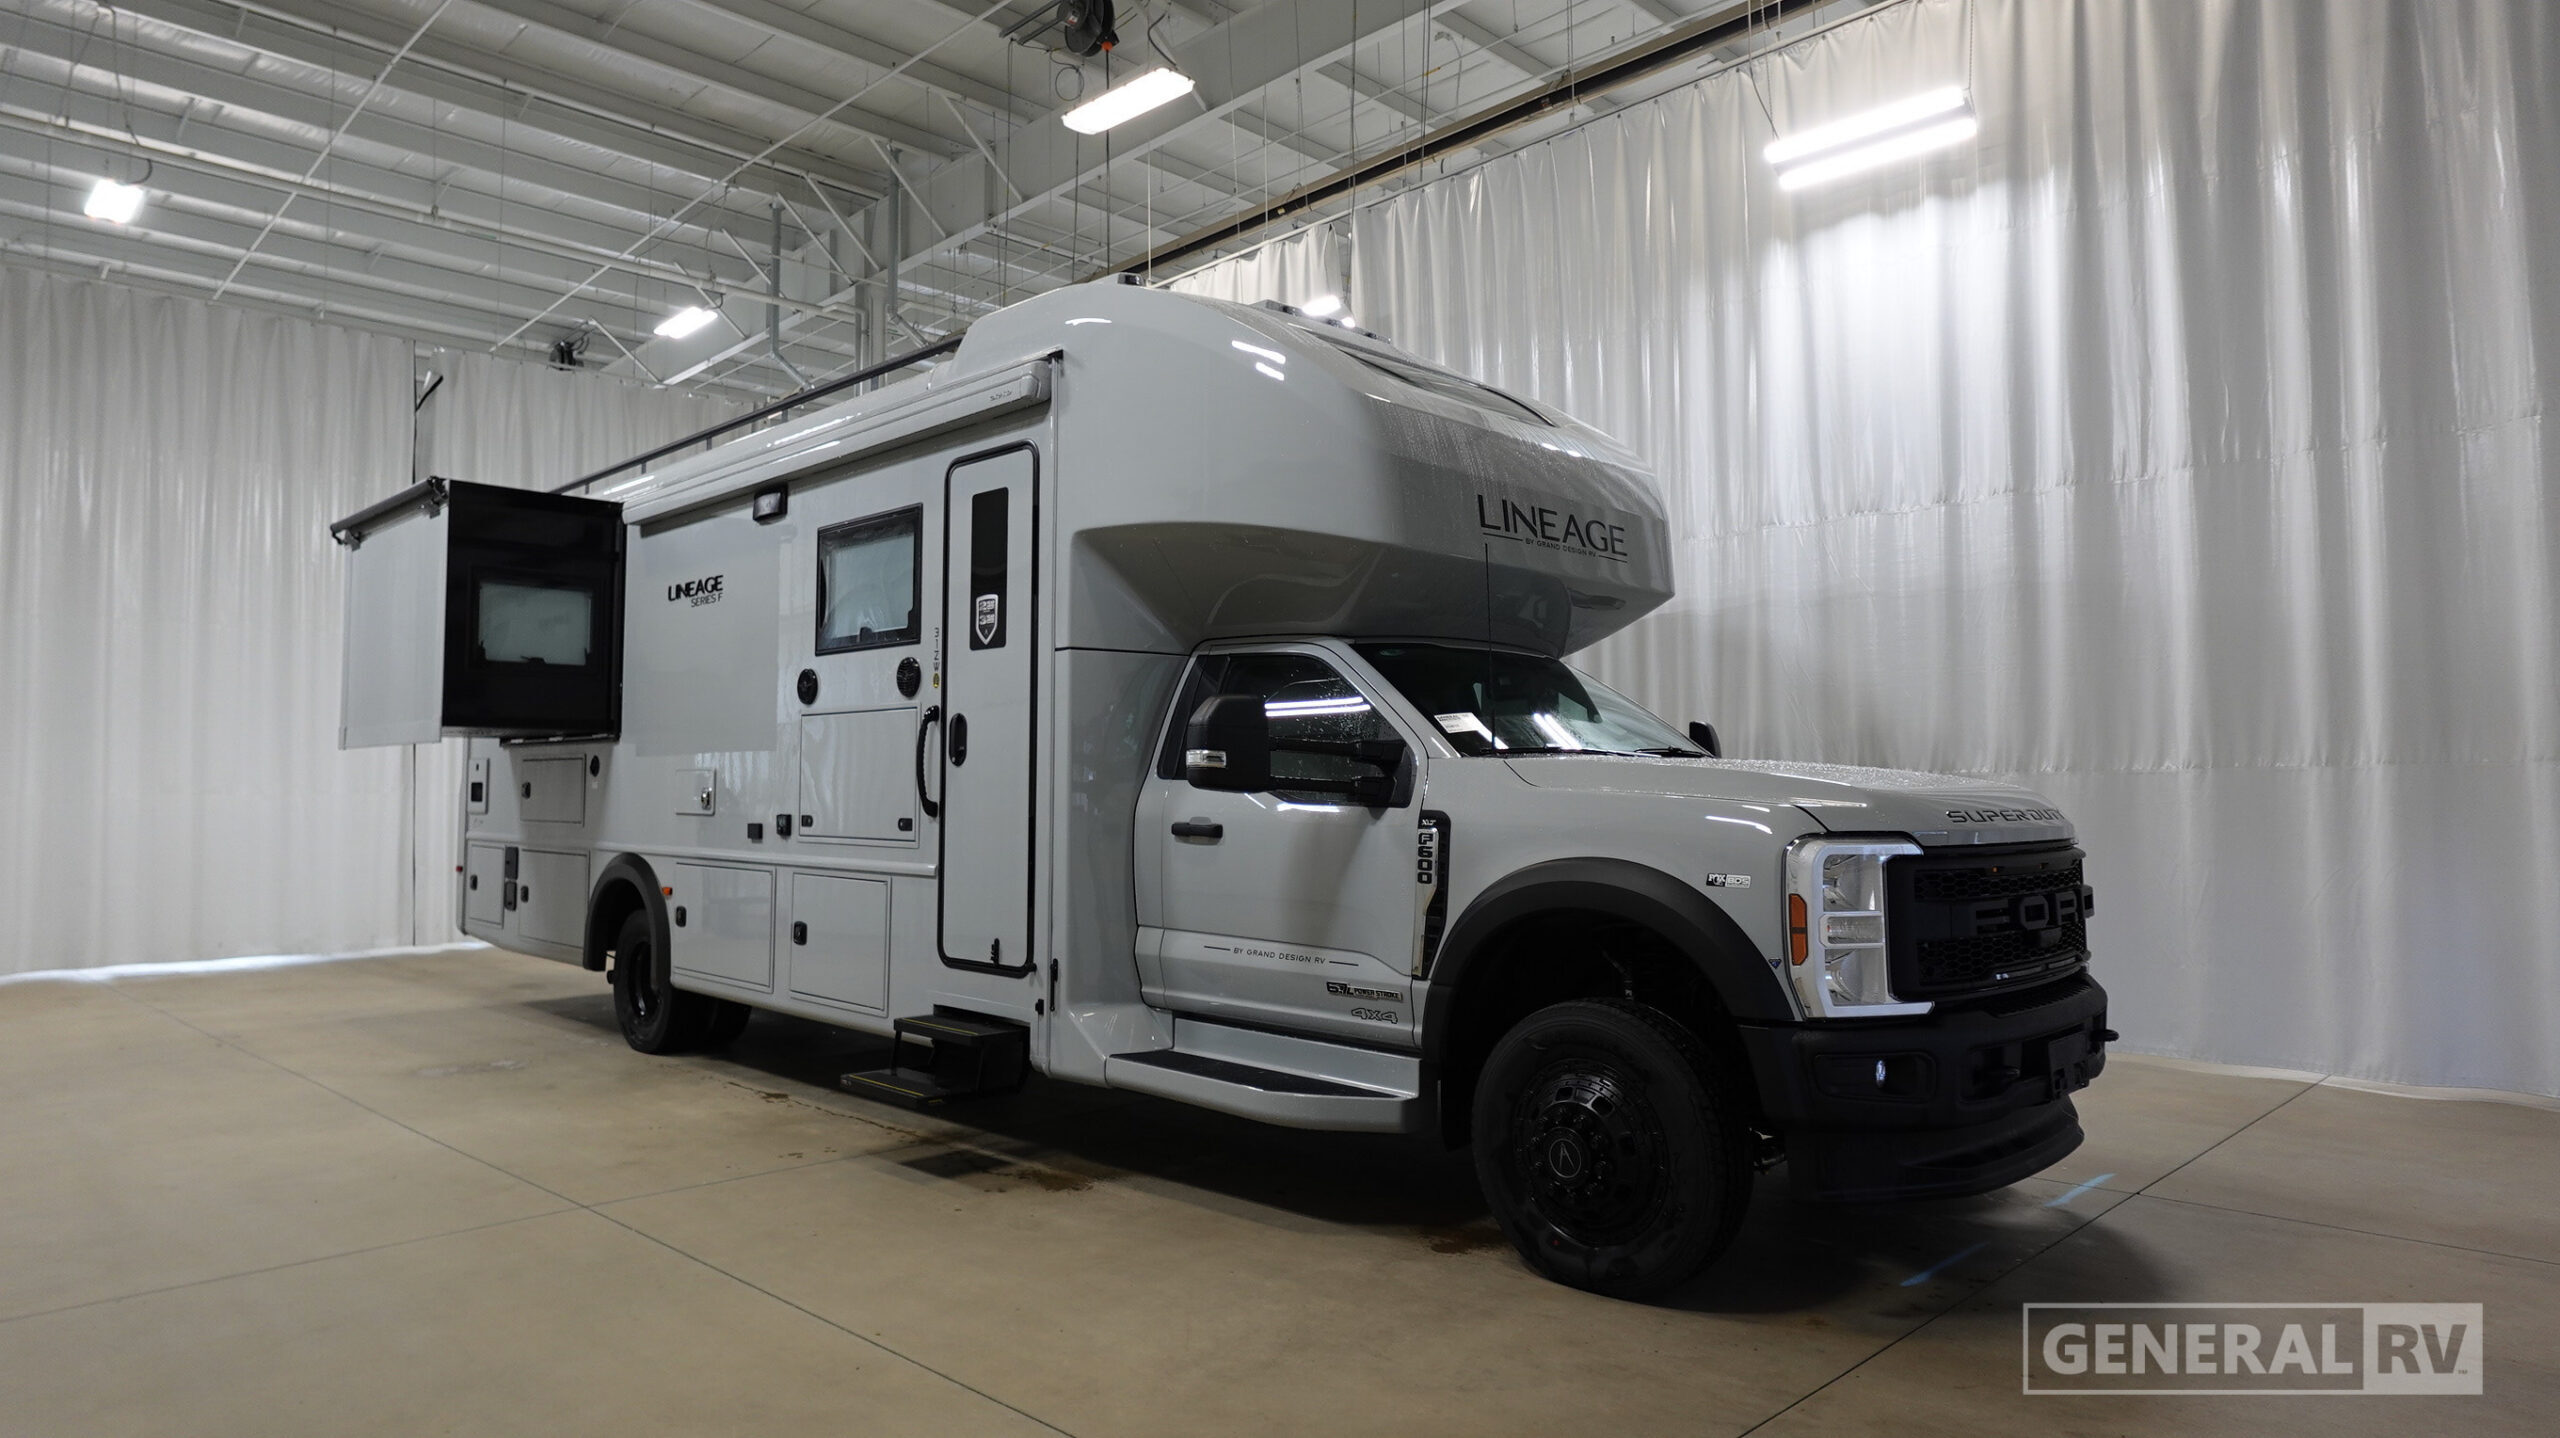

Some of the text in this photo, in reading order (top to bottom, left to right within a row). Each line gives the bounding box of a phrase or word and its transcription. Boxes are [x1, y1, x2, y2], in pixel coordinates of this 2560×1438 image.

[1477, 493, 1628, 557] LINEAGE
[1537, 540, 1560, 551] GRAND
[1562, 544, 1587, 556] DESIGN
[668, 574, 724, 602] LINEAGE
[691, 592, 724, 608] SERIES F
[1417, 833, 1433, 884] F600
[1708, 873, 1726, 886] FOX
[1246, 948, 1276, 959] GRAND
[1278, 952, 1312, 963] DESIGN
[1314, 956, 1326, 964] RV
